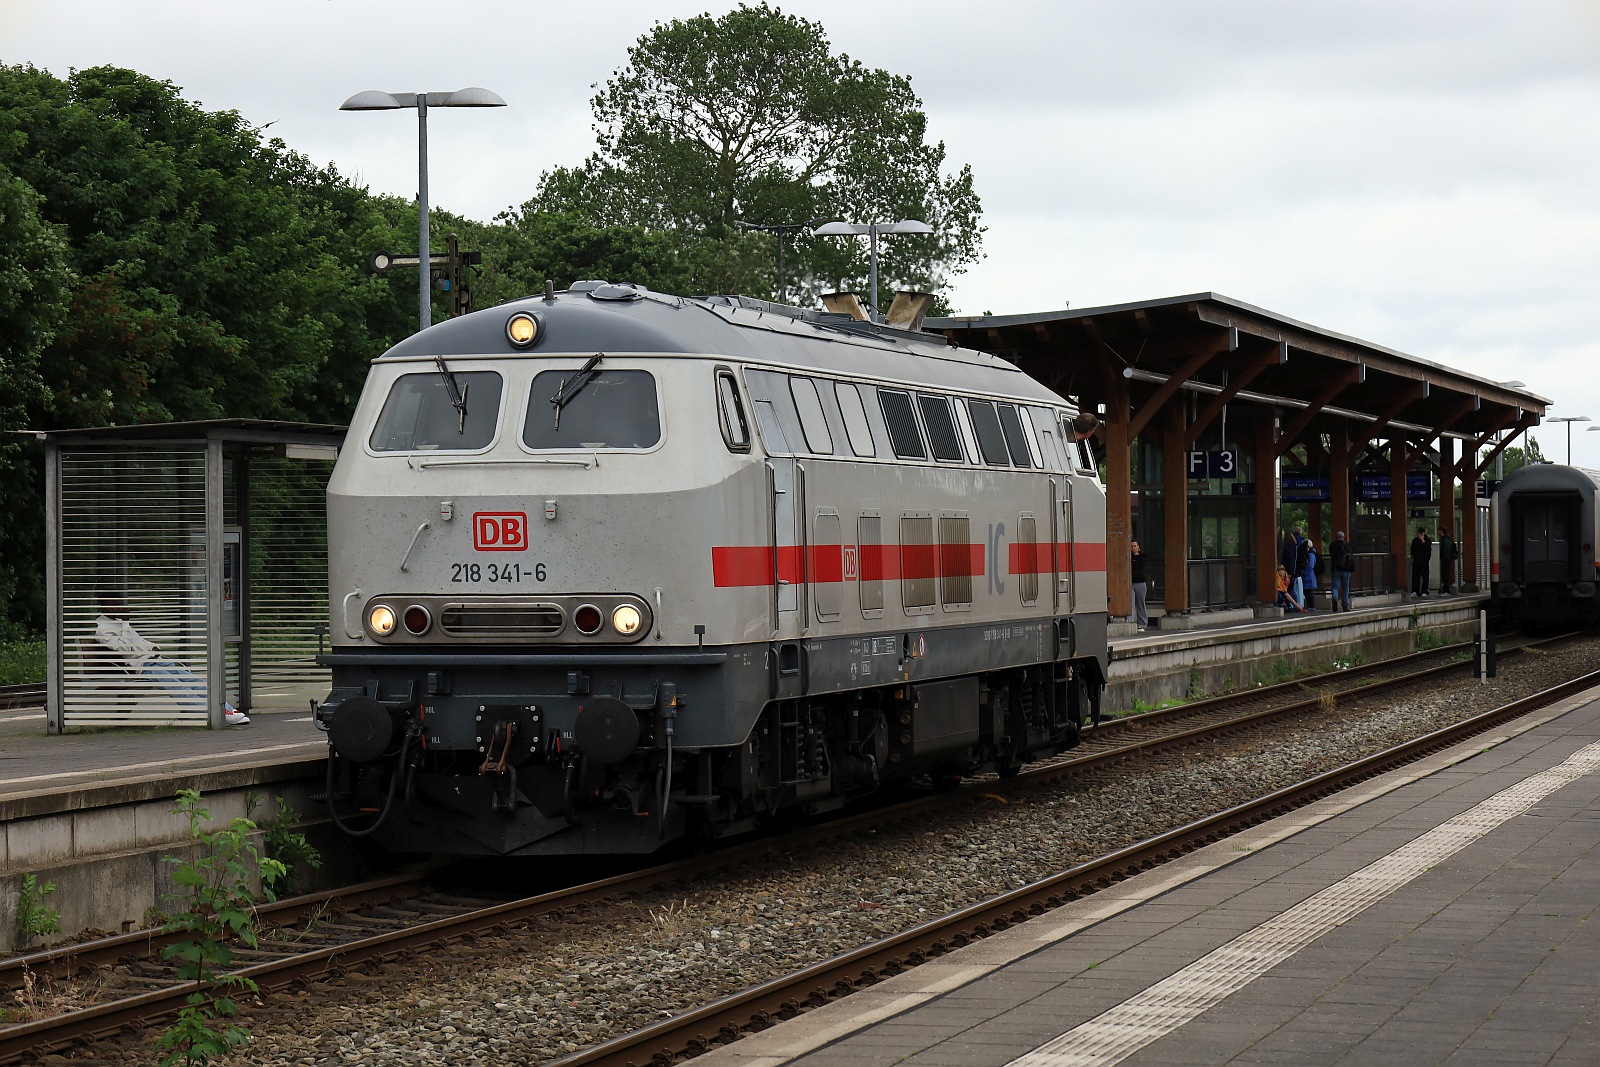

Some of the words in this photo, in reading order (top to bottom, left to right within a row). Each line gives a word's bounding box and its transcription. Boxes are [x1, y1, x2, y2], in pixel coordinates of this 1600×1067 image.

[1190, 451, 1204, 473] F
[1219, 450, 1234, 473] 3
[1475, 480, 1485, 494] E
[479, 518, 522, 545] DB
[844, 550, 856, 575] DB
[987, 522, 1006, 596] IC
[451, 562, 482, 583] 218
[487, 562, 547, 583] 341-6
[764, 650, 769, 669] 2
